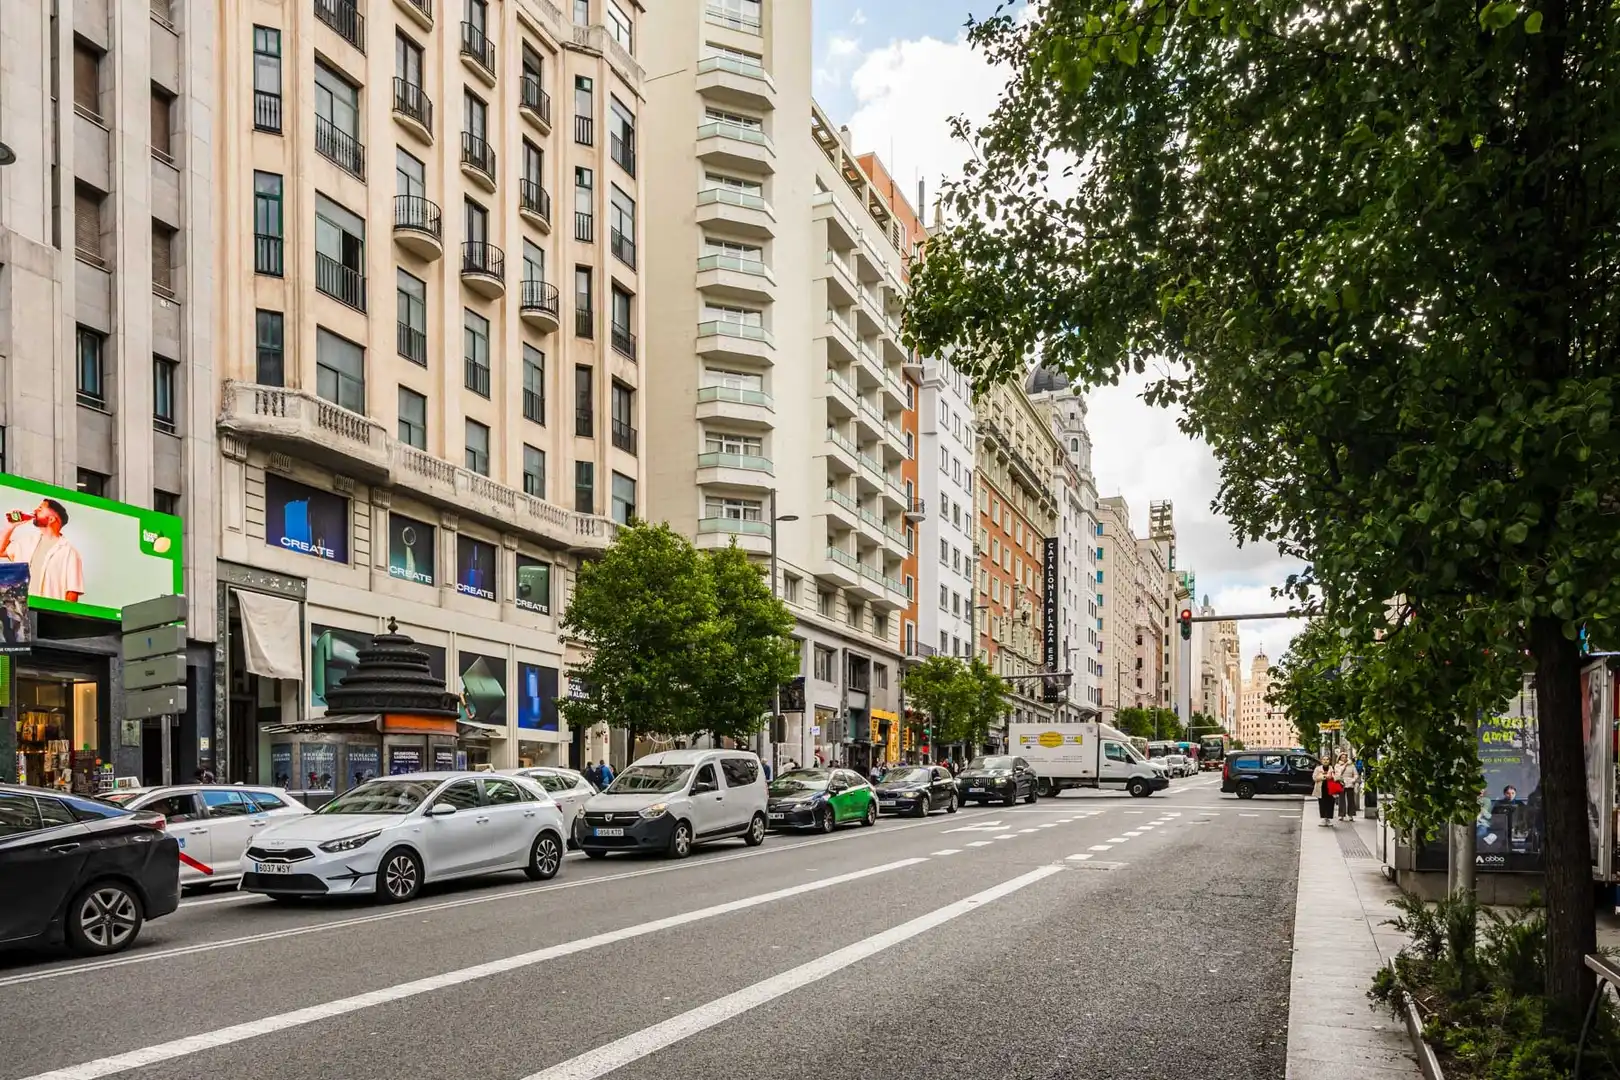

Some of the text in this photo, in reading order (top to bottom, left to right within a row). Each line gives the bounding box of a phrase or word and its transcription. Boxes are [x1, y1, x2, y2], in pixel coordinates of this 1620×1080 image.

[280, 537, 334, 558] CREATE
[389, 565, 432, 584] CREATE
[456, 583, 494, 600] CREATE
[515, 598, 548, 613] CREATE
[568, 683, 582, 692] OCAL
